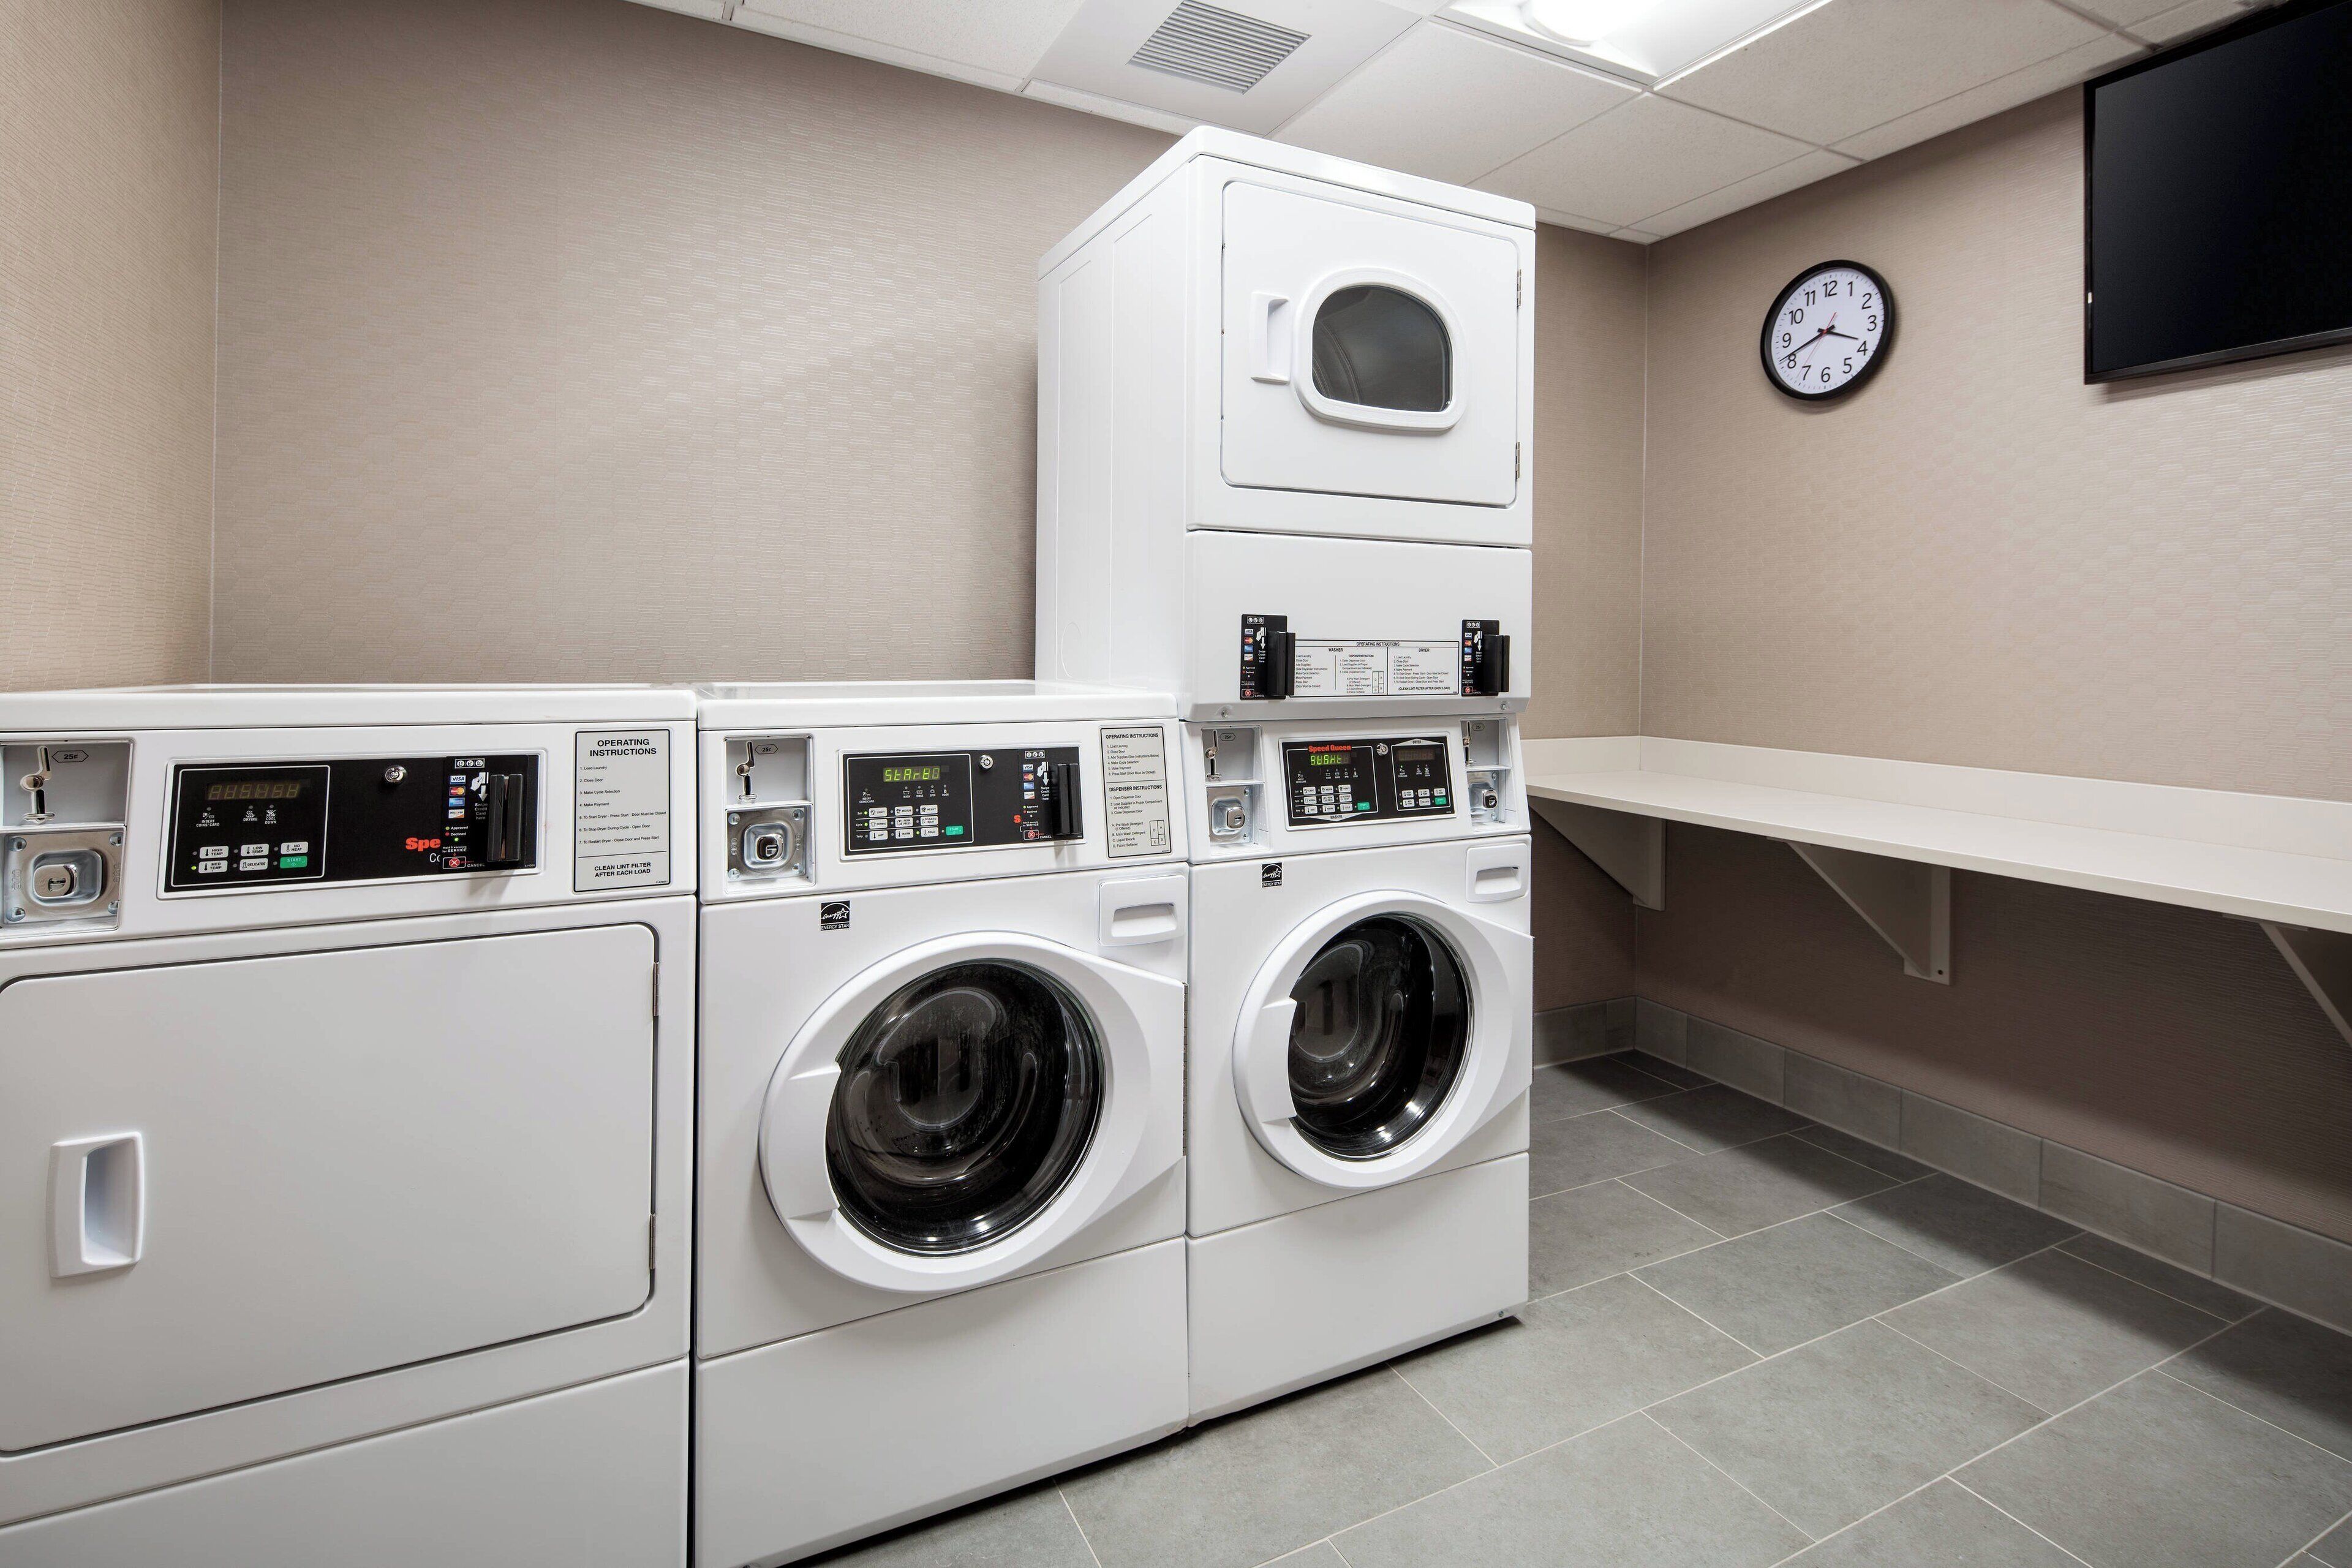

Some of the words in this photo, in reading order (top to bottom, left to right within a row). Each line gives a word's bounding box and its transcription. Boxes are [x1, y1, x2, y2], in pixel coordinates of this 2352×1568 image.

[1822, 281, 1838, 297] 12
[1847, 281, 1853, 296] 1
[1805, 290, 1815, 306] 11
[1861, 293, 1872, 309] 2
[1789, 308, 1804, 325] 10
[1867, 315, 1877, 331] 3
[1782, 333, 1791, 348] 9
[1856, 341, 1868, 356] 4
[1787, 353, 1796, 369] 8
[1842, 357, 1852, 374] 5
[1802, 365, 1811, 381] 7
[1821, 367, 1830, 383] 6
[590, 748, 657, 756] INSTRUCTIONS
